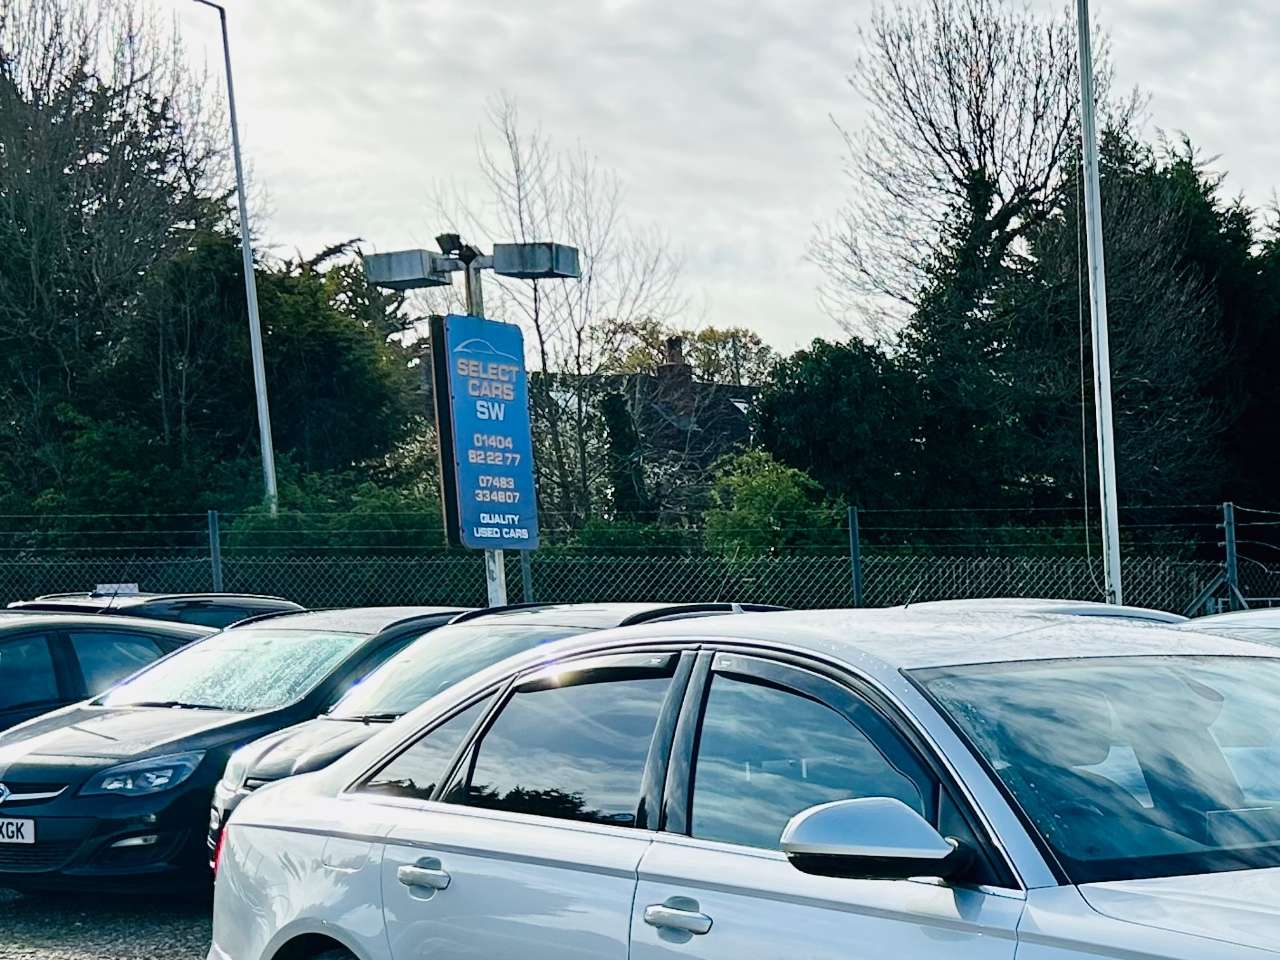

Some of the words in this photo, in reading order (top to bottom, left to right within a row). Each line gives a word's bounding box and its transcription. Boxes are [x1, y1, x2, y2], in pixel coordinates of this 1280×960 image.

[457, 358, 519, 382] SELECT
[469, 379, 514, 401] CARS
[476, 400, 505, 421] SW
[473, 433, 513, 449] 01404
[474, 489, 520, 503] 334807
[480, 512, 519, 525] QUALITY
[473, 526, 500, 538] USED
[502, 528, 529, 539] CARS
